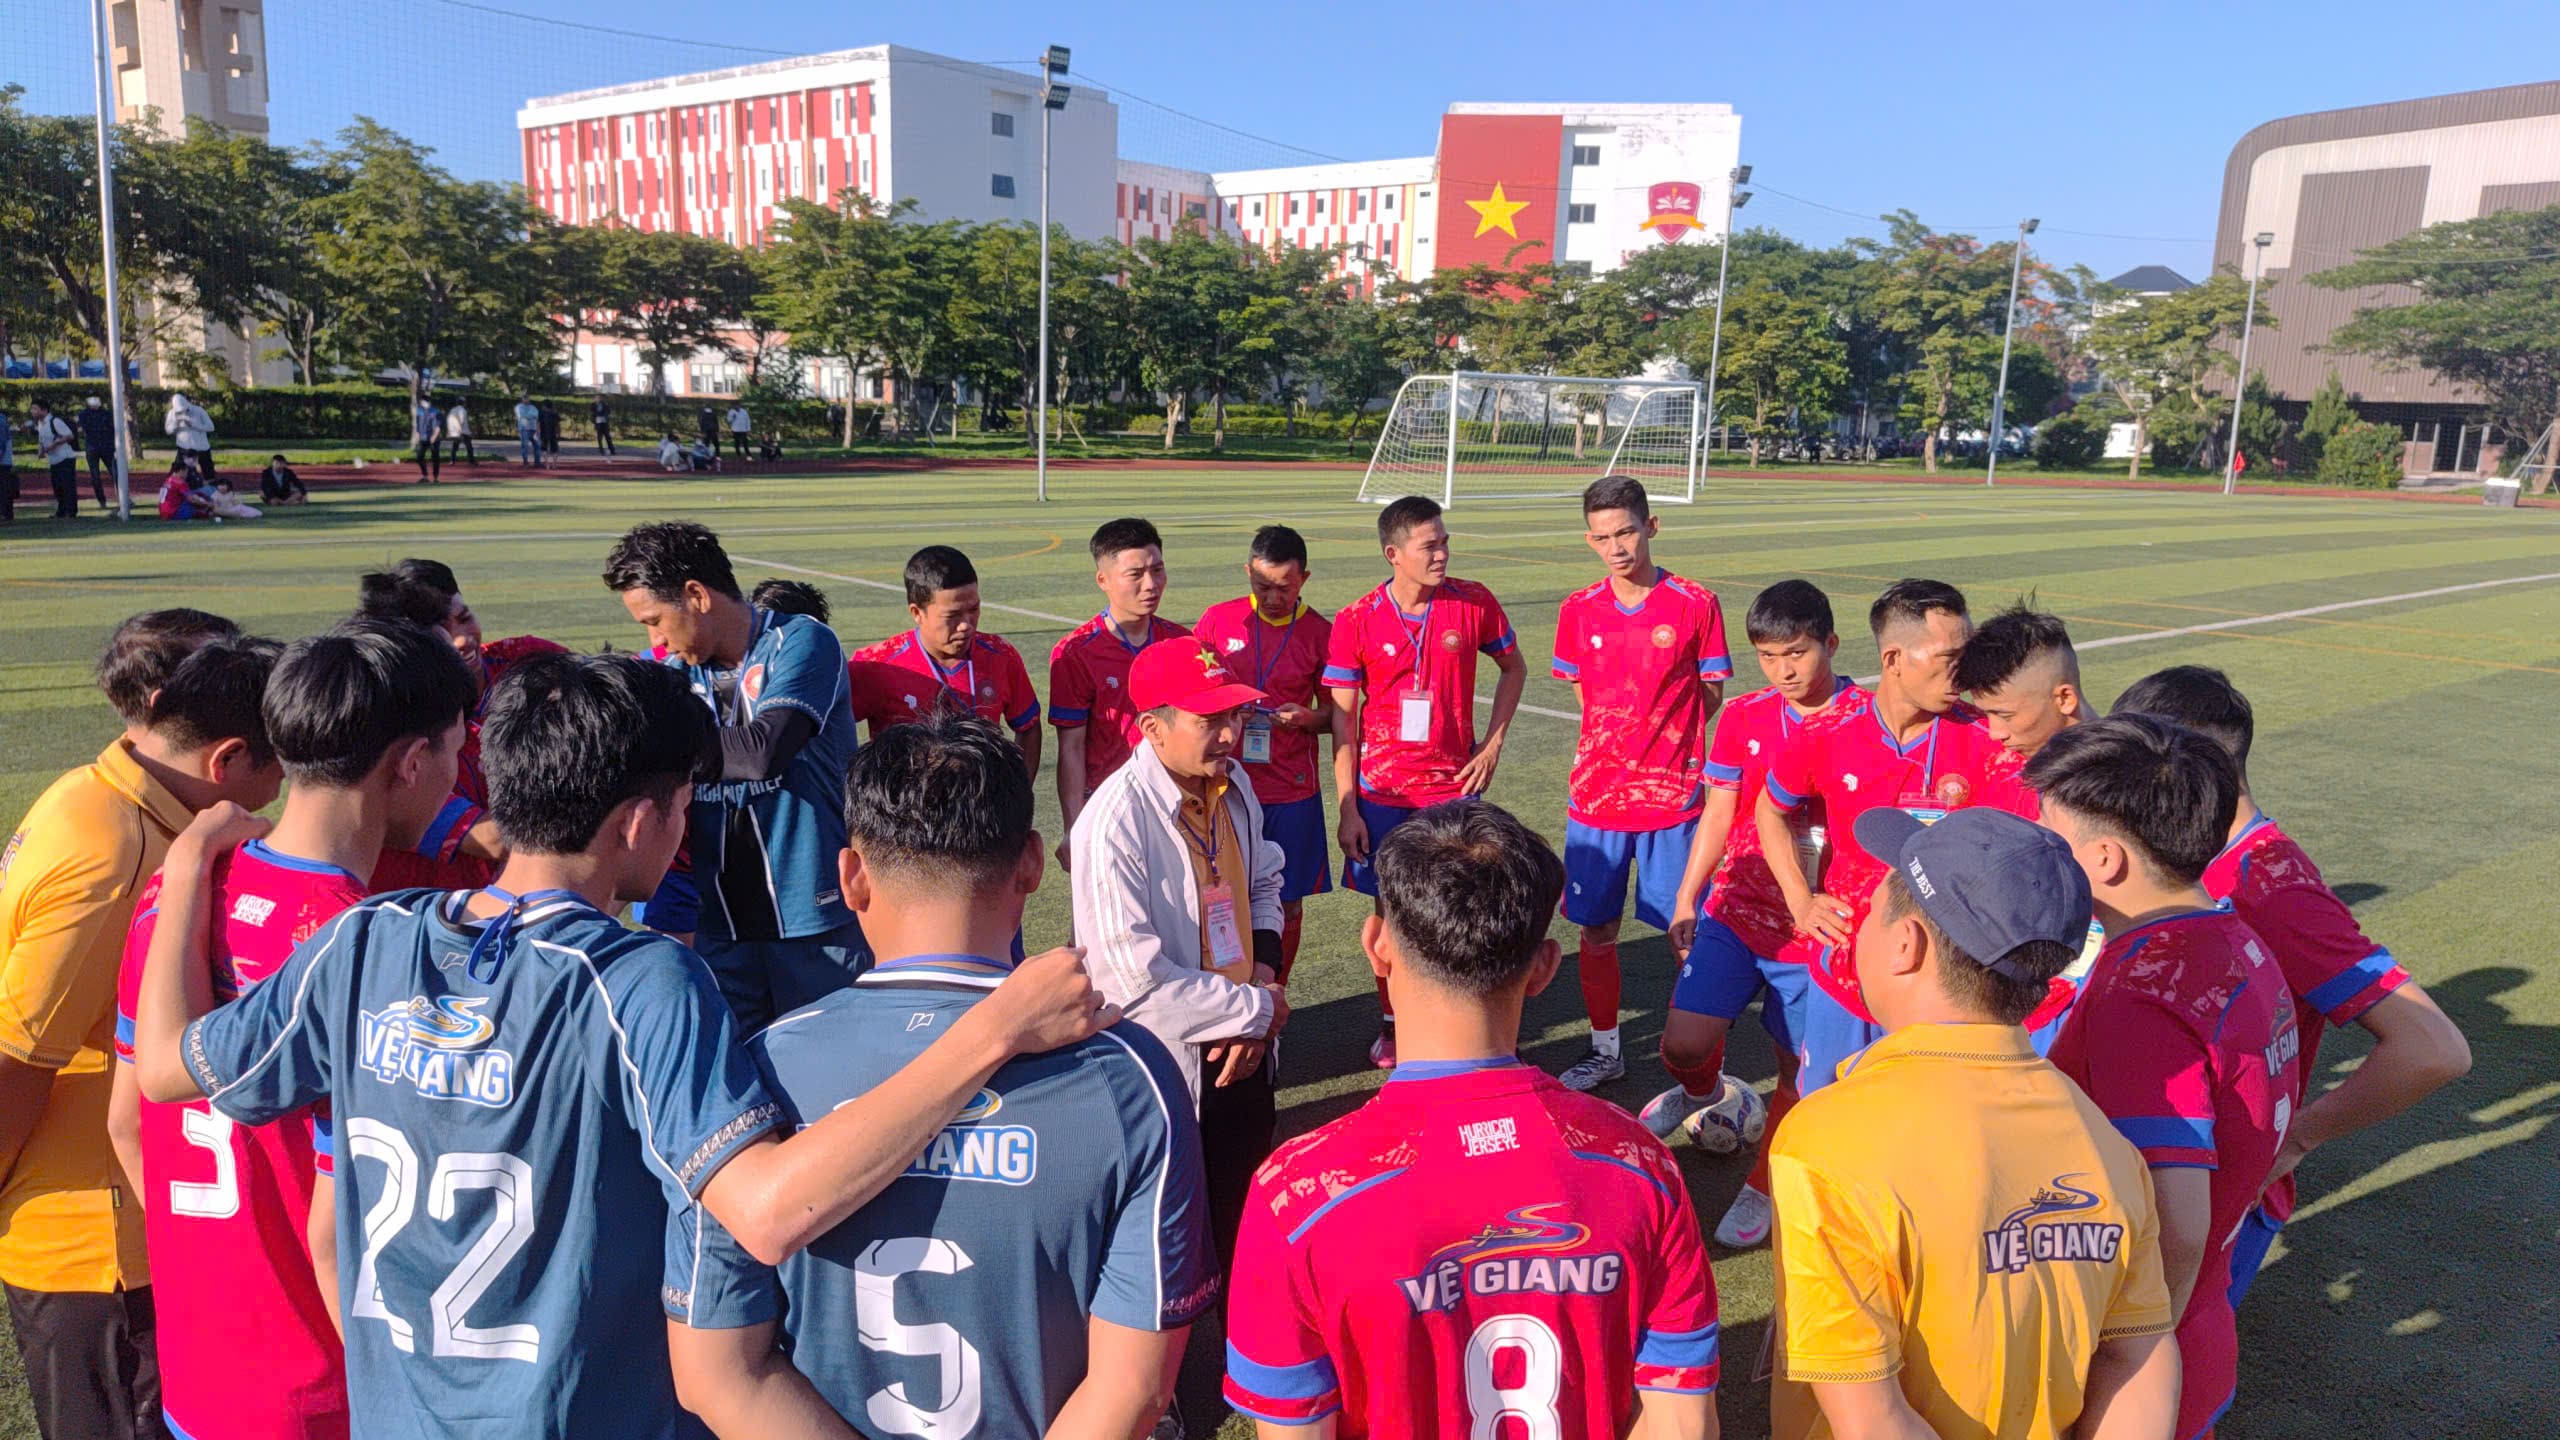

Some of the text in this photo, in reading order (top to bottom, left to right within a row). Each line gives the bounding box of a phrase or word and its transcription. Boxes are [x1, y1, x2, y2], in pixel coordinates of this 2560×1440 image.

[1908, 856, 1936, 899] THE BEST
[346, 1117, 540, 1364] 22
[1404, 1254, 1620, 1312] VỆ GIANG
[1988, 1221, 2121, 1271] VỆ GIANG
[854, 1236, 982, 1440] 5
[1464, 1313, 1562, 1440] 8
